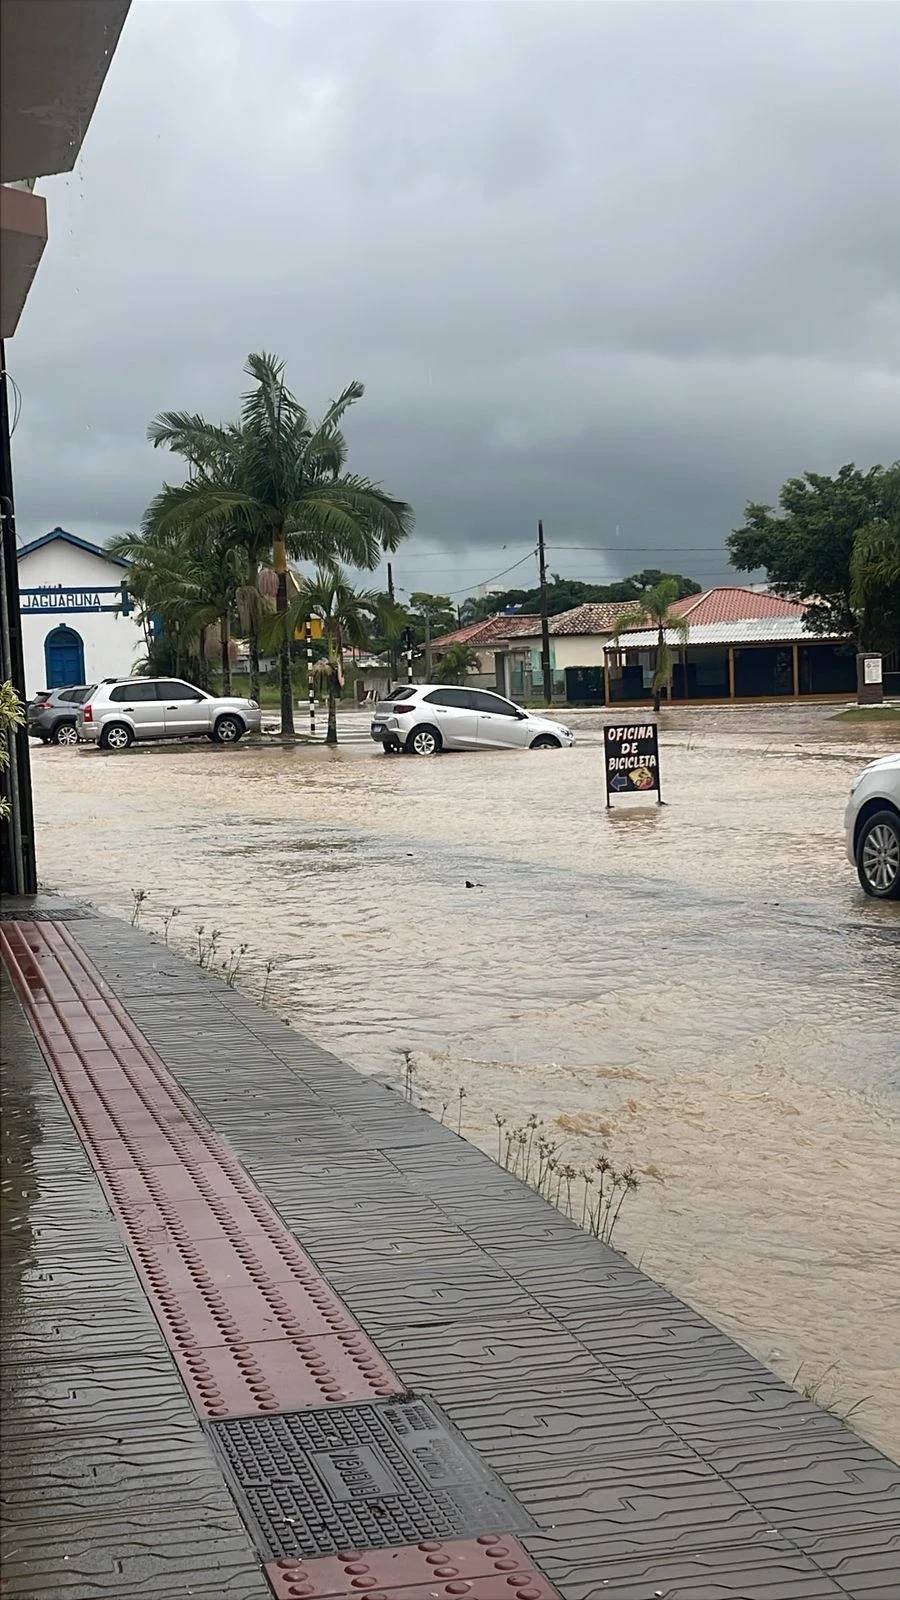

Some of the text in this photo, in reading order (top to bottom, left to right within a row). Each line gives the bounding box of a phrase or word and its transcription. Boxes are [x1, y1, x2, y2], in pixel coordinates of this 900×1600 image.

[22, 593, 101, 608] JAGUARUNA
[607, 726, 654, 741] OFICINA
[621, 742, 638, 754] DE
[608, 755, 657, 771] BICICLETA
